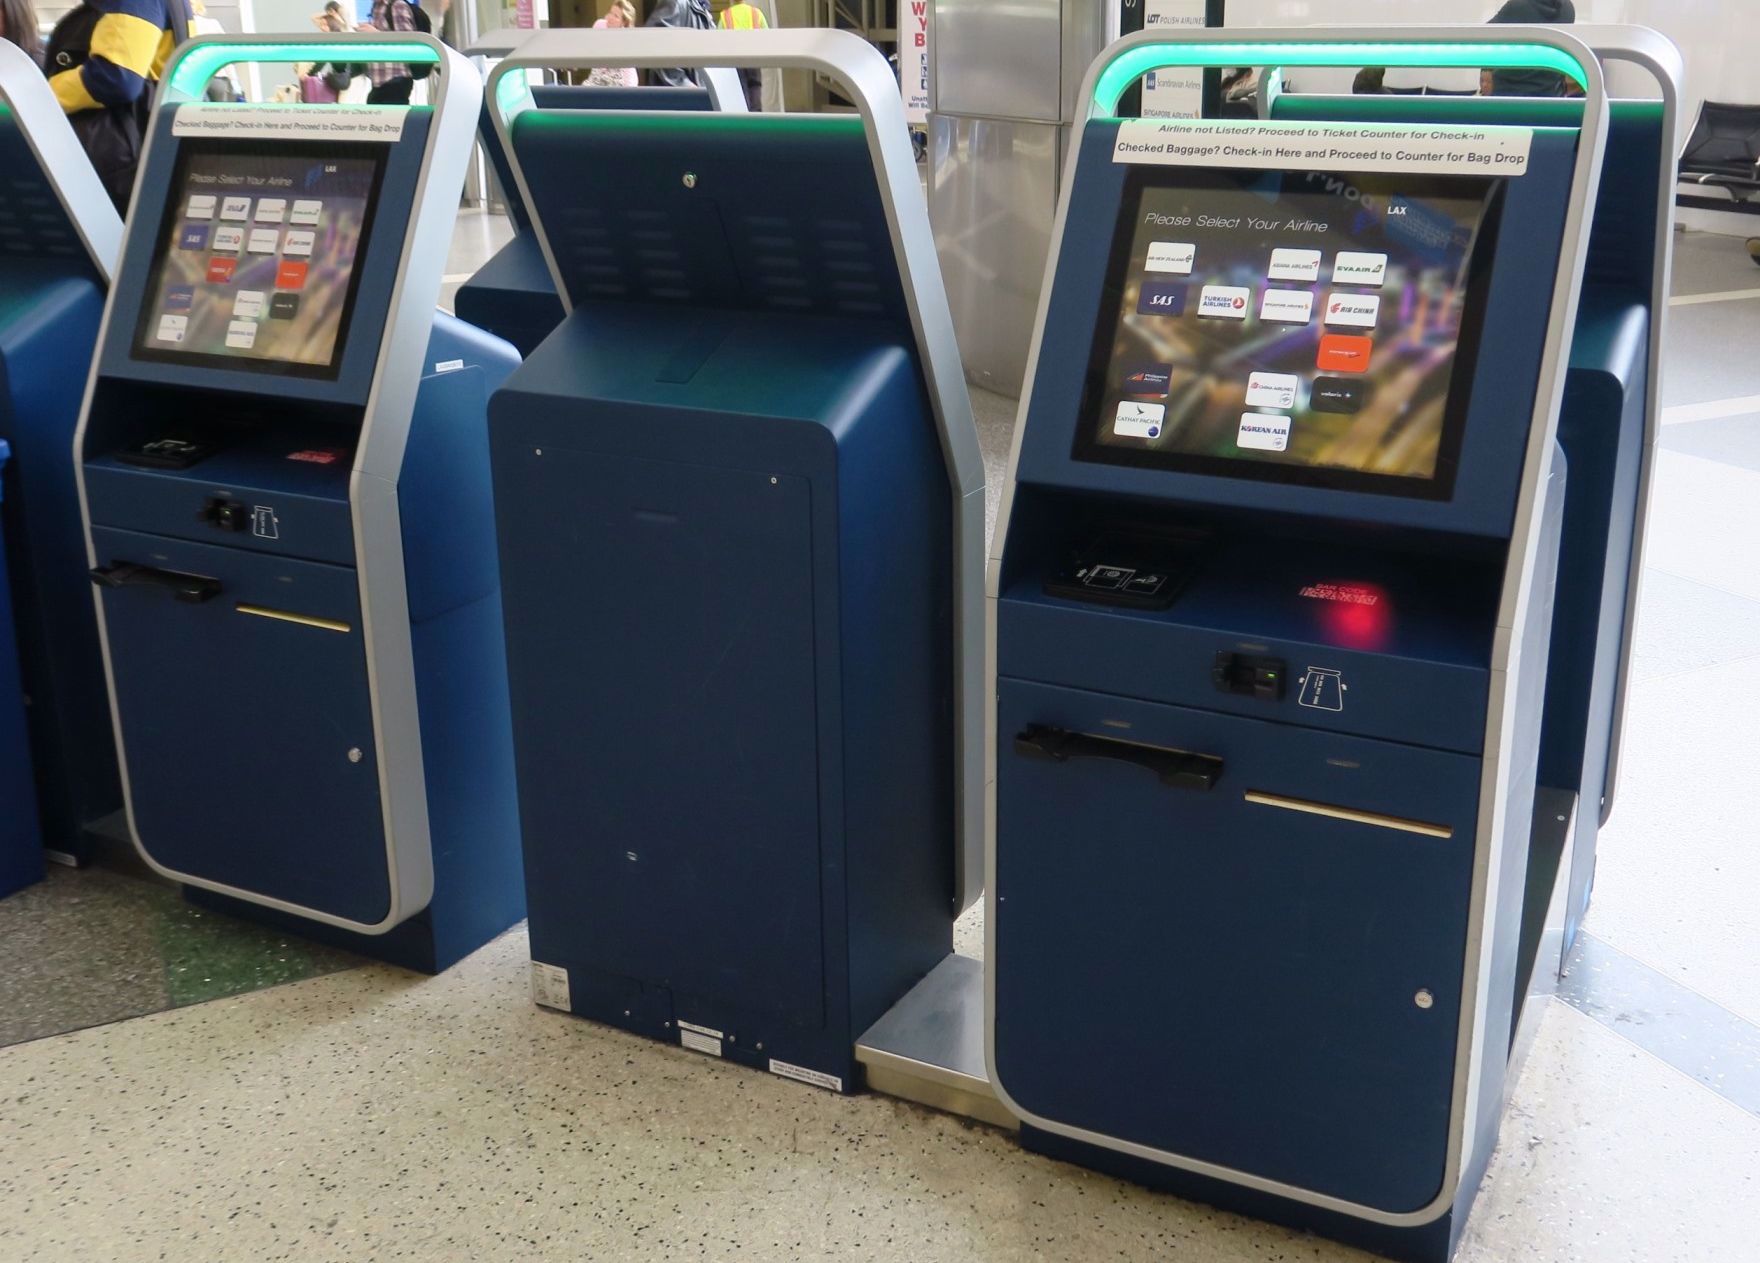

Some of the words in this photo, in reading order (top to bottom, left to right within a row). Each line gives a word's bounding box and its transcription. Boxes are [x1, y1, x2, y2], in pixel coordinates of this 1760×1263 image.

[1147, 14, 1160, 24] LOT
[1160, 16, 1180, 25] POLISH
[1181, 16, 1206, 25] AIRLINES
[1158, 124, 1192, 134] Airline
[1195, 126, 1212, 134] not
[1215, 126, 1256, 135] Listed?
[1258, 128, 1305, 136] Proceed
[1308, 128, 1319, 137] to
[1323, 129, 1357, 138] Ticket
[1360, 130, 1407, 139] Counter
[1410, 130, 1428, 139] for
[1430, 131, 1485, 140] Check-in
[1118, 142, 1164, 153] Checked
[1166, 144, 1220, 156] Baggage?
[1223, 146, 1272, 157] Check-in
[1275, 148, 1301, 158] Here
[1304, 148, 1326, 158] and
[1329, 150, 1377, 160] Proceed
[1380, 151, 1392, 160] to
[1396, 150, 1444, 162] Counter
[1446, 152, 1464, 162] for
[1467, 152, 1491, 164] Bag
[1494, 154, 1525, 164] Drop
[190, 172, 217, 184] Please
[218, 174, 244, 184] Select
[1387, 206, 1408, 215] LAX
[1144, 212, 1192, 226] Please
[1195, 215, 1240, 228] Select
[1247, 217, 1280, 230] Your
[1283, 219, 1328, 233] Airline
[1150, 294, 1175, 306] SAS
[1240, 425, 1272, 434] KOREAN
[1272, 428, 1287, 436] AIR
